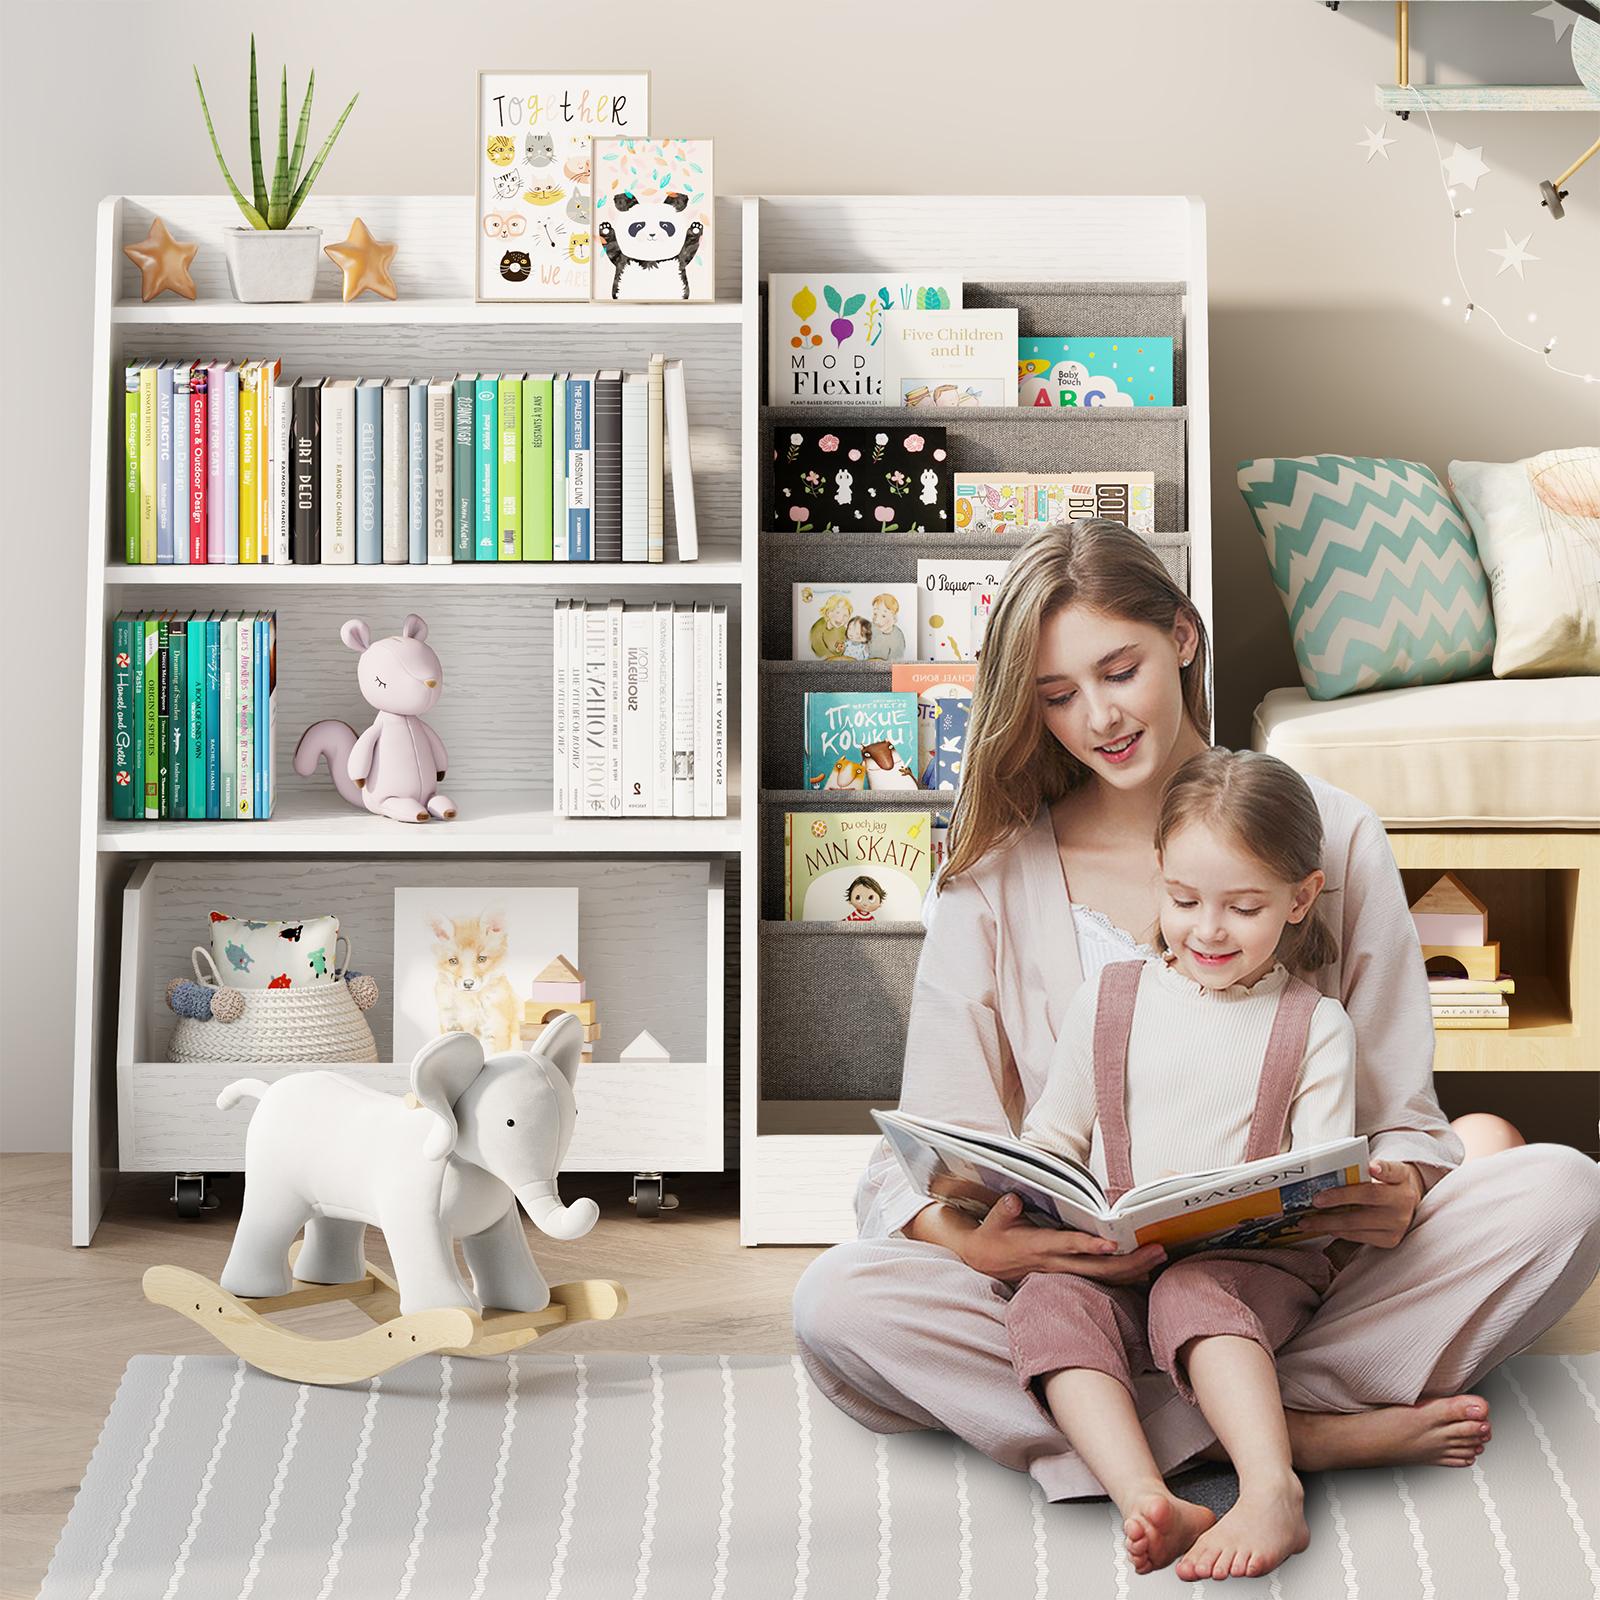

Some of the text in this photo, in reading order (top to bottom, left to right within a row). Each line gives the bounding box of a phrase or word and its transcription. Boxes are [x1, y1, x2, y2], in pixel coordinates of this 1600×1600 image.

[902, 327, 1004, 342] Five Children
[930, 344, 976, 358] and It
[574, 384, 583, 399] THE
[1058, 370, 1079, 379] Baby
[1058, 378, 1081, 386] Touch
[434, 397, 445, 433] TOLSTOY
[532, 395, 543, 406] ANS
[574, 399, 583, 419] PALEO
[160, 392, 171, 462] ANTARCTIC
[211, 387, 221, 477] LUXURY FOR CATS
[243, 409, 253, 432] Cool
[457, 396, 473, 447] ELEANOR RIGBY
[128, 412, 139, 494] Ecological Design
[176, 400, 187, 492] Kitchen Design
[192, 399, 204, 524] Garden & Outdoor Design
[243, 433, 253, 464] Hotels
[434, 437, 445, 475] WAR
[298, 436, 313, 510] ART DECO
[574, 452, 583, 486] MISSING
[574, 487, 583, 505] LINK
[1098, 486, 1127, 527] COL
[434, 488, 445, 539] PEACE
[925, 573, 936, 592] O
[172, 650, 181, 721] Dreaming of Sweden
[195, 687, 203, 706] ROOM
[116, 672, 130, 767] Hansel and Gretel
[148, 679, 156, 757] ORIGIN OF SPECIES
[195, 706, 203, 716] OF
[195, 740, 203, 760] OWN
[173, 760, 181, 783] Andrew
[841, 819, 888, 834] Du och jag
[805, 834, 926, 876] MIN SKATT
[1183, 1165, 1306, 1208] BACON
